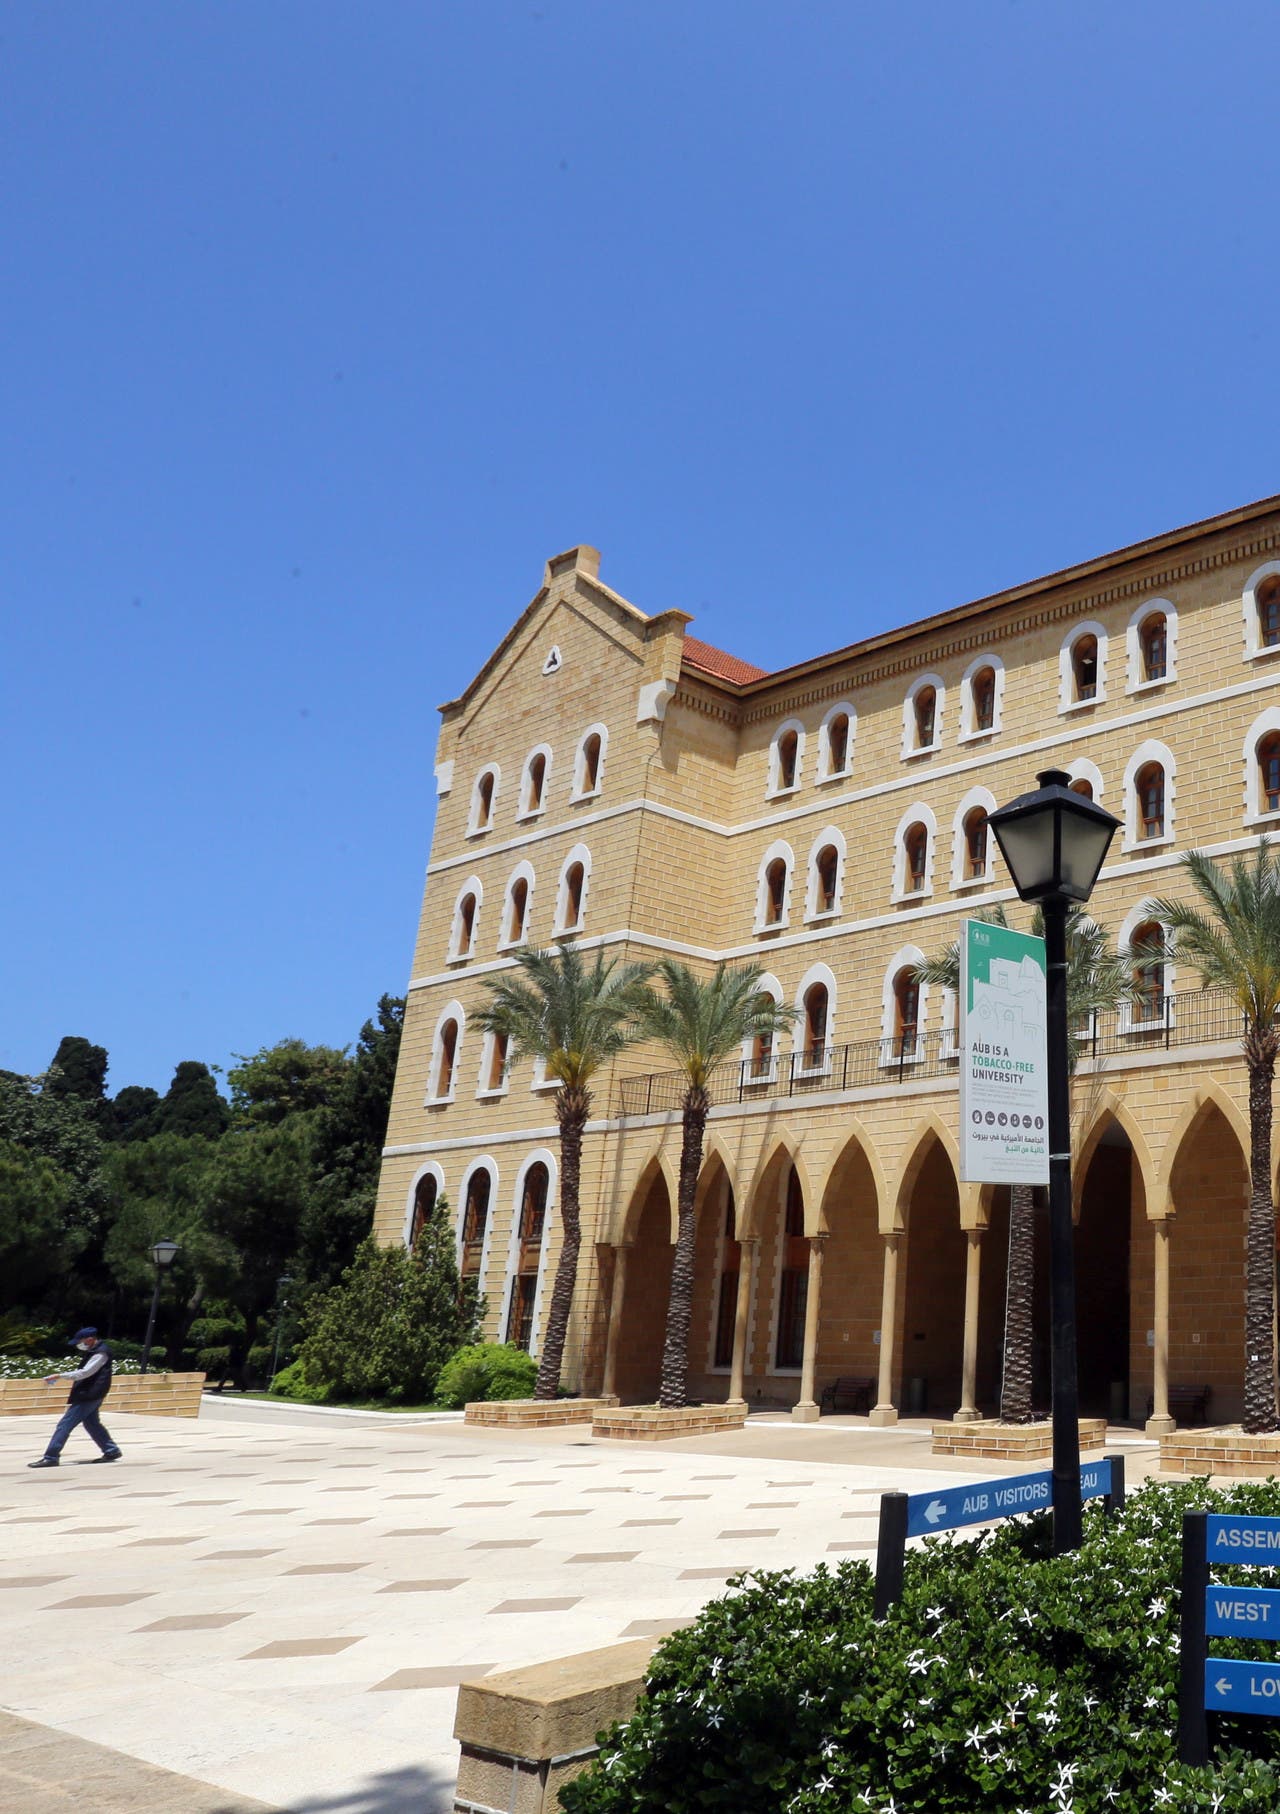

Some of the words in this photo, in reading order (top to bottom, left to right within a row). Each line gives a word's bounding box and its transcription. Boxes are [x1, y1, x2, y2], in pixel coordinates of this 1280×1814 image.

[972, 1042, 990, 1054] AUB
[992, 1045, 1001, 1056] IS
[1003, 1047, 1009, 1057] A
[972, 1055, 1035, 1073] TOBACCO-FREE
[972, 1068, 1024, 1084] UNIVERSITY
[972, 1132, 988, 1142] بيروت
[990, 1134, 1000, 1142] في
[962, 1494, 989, 1515] AUB
[995, 1481, 1049, 1507] VISITORS
[1215, 1600, 1271, 1622] WEST
